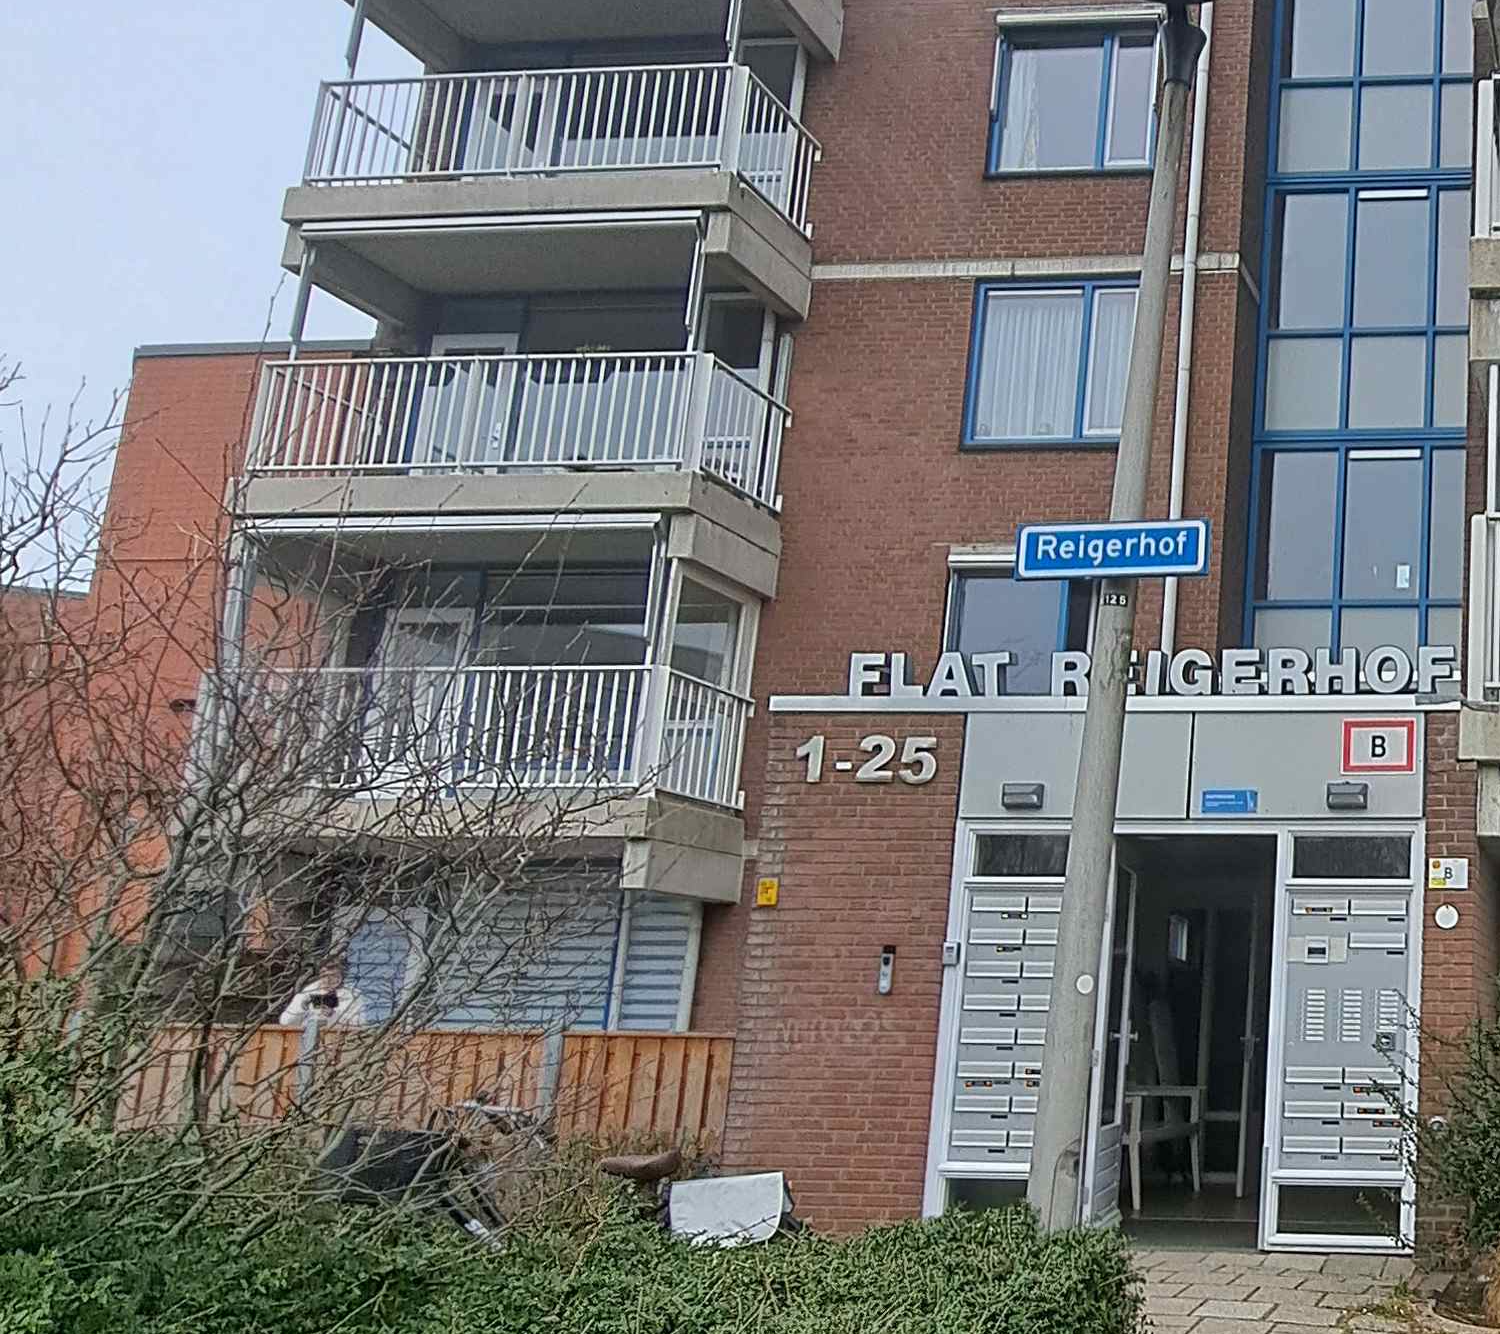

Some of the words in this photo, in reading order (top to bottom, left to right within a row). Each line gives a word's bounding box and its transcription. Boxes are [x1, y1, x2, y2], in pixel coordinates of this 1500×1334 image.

[1037, 531, 1188, 566] Reigerhof
[849, 652, 1011, 697] FLAT
[1051, 646, 1455, 697] RIGERHOF
[796, 735, 937, 785] 1-25
[1370, 734, 1387, 758] B
[1444, 866, 1453, 879] B
